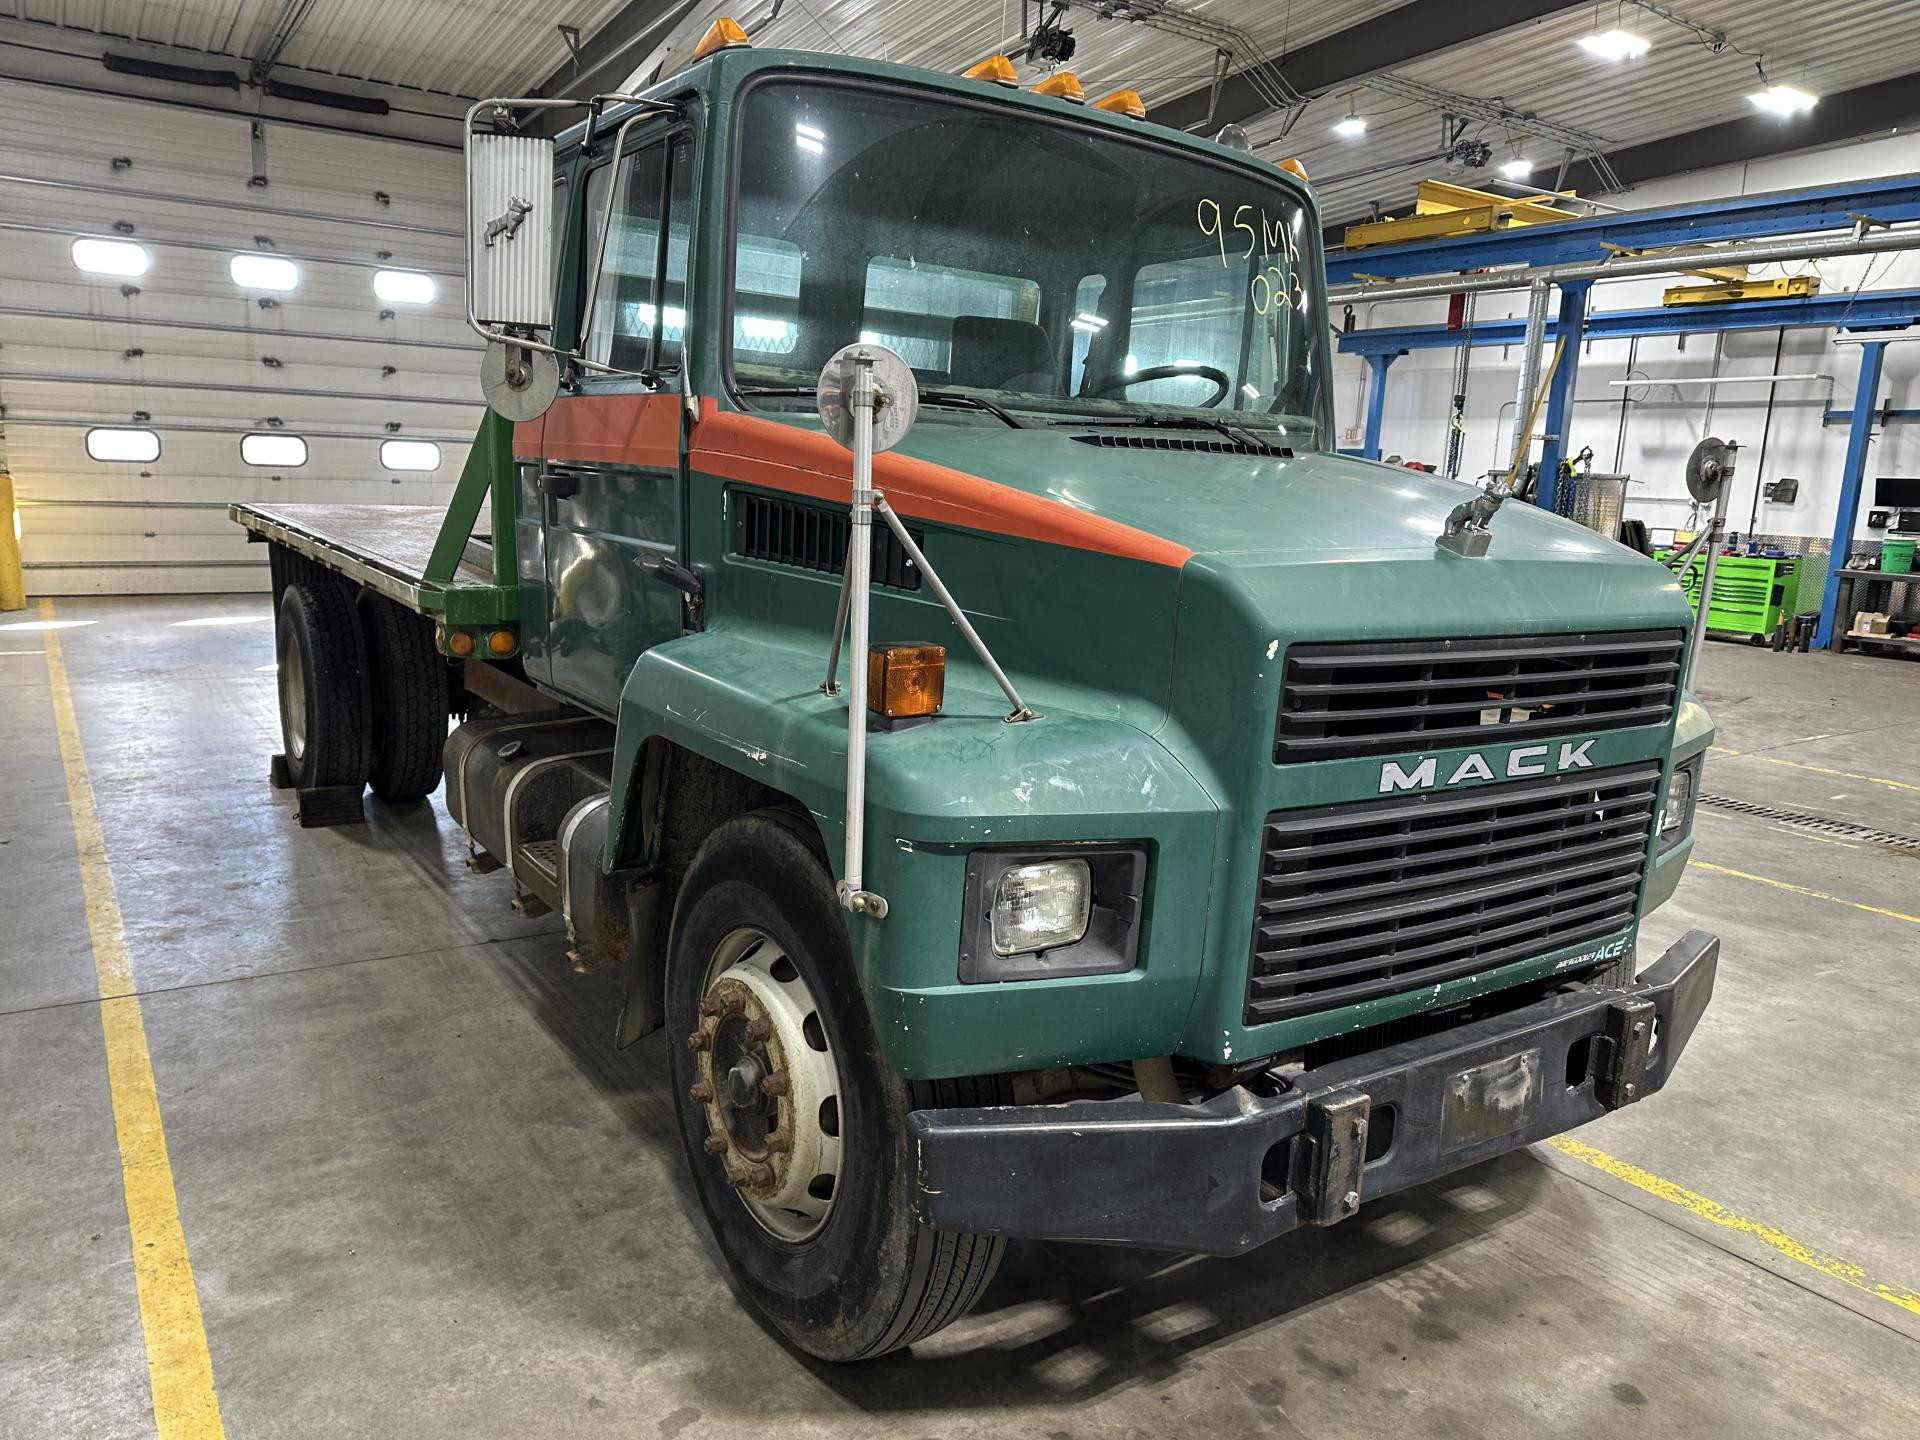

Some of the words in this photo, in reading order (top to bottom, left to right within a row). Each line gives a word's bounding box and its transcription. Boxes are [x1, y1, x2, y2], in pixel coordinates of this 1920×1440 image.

[1251, 266, 1303, 315] 023
[1378, 738, 1598, 793] MACK
[1593, 940, 1625, 962] ACE
